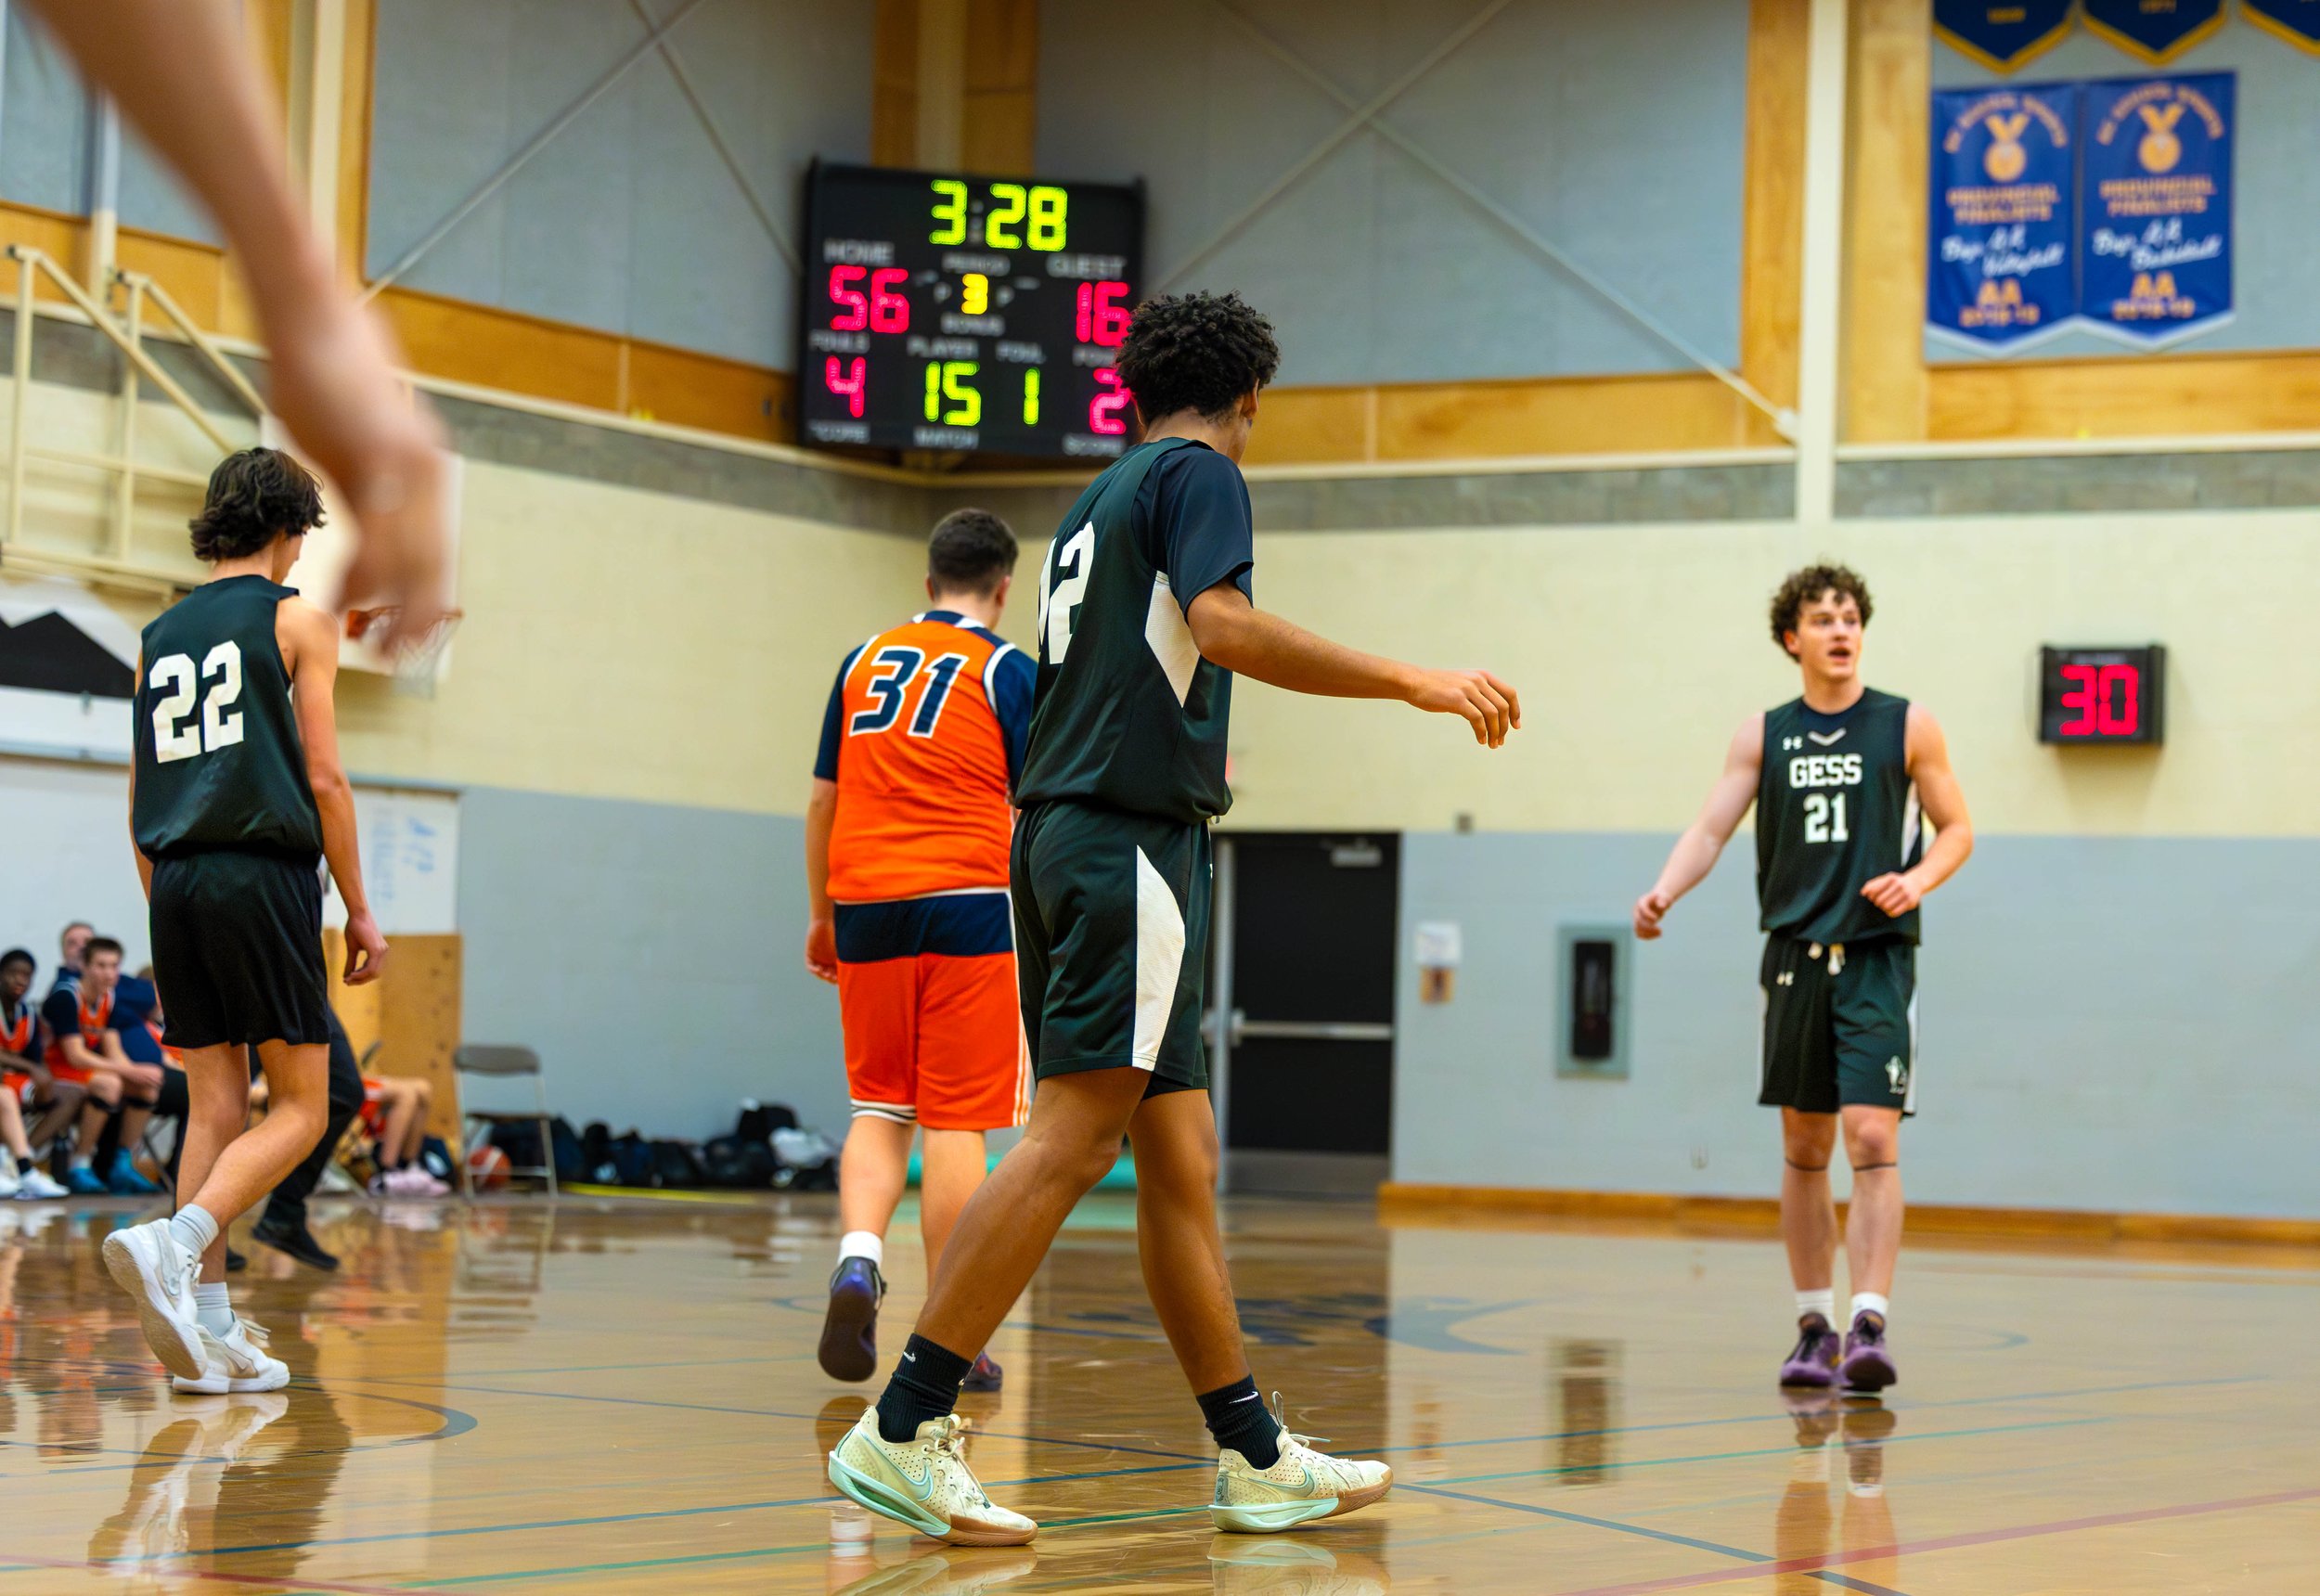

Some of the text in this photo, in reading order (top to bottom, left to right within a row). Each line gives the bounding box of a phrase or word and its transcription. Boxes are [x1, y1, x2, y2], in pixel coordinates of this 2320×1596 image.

[830, 264, 910, 334] 56
[960, 273, 989, 315] 3
[1076, 280, 1131, 347] 16
[825, 355, 866, 418] 4
[923, 360, 982, 427] 15
[1024, 367, 1040, 427] 1
[1089, 367, 1131, 435] 2
[148, 639, 245, 764] 22
[848, 645, 970, 739] 31
[2058, 663, 2139, 736] 30
[1788, 753, 1862, 789] GESS
[1802, 792, 1850, 844] 21
